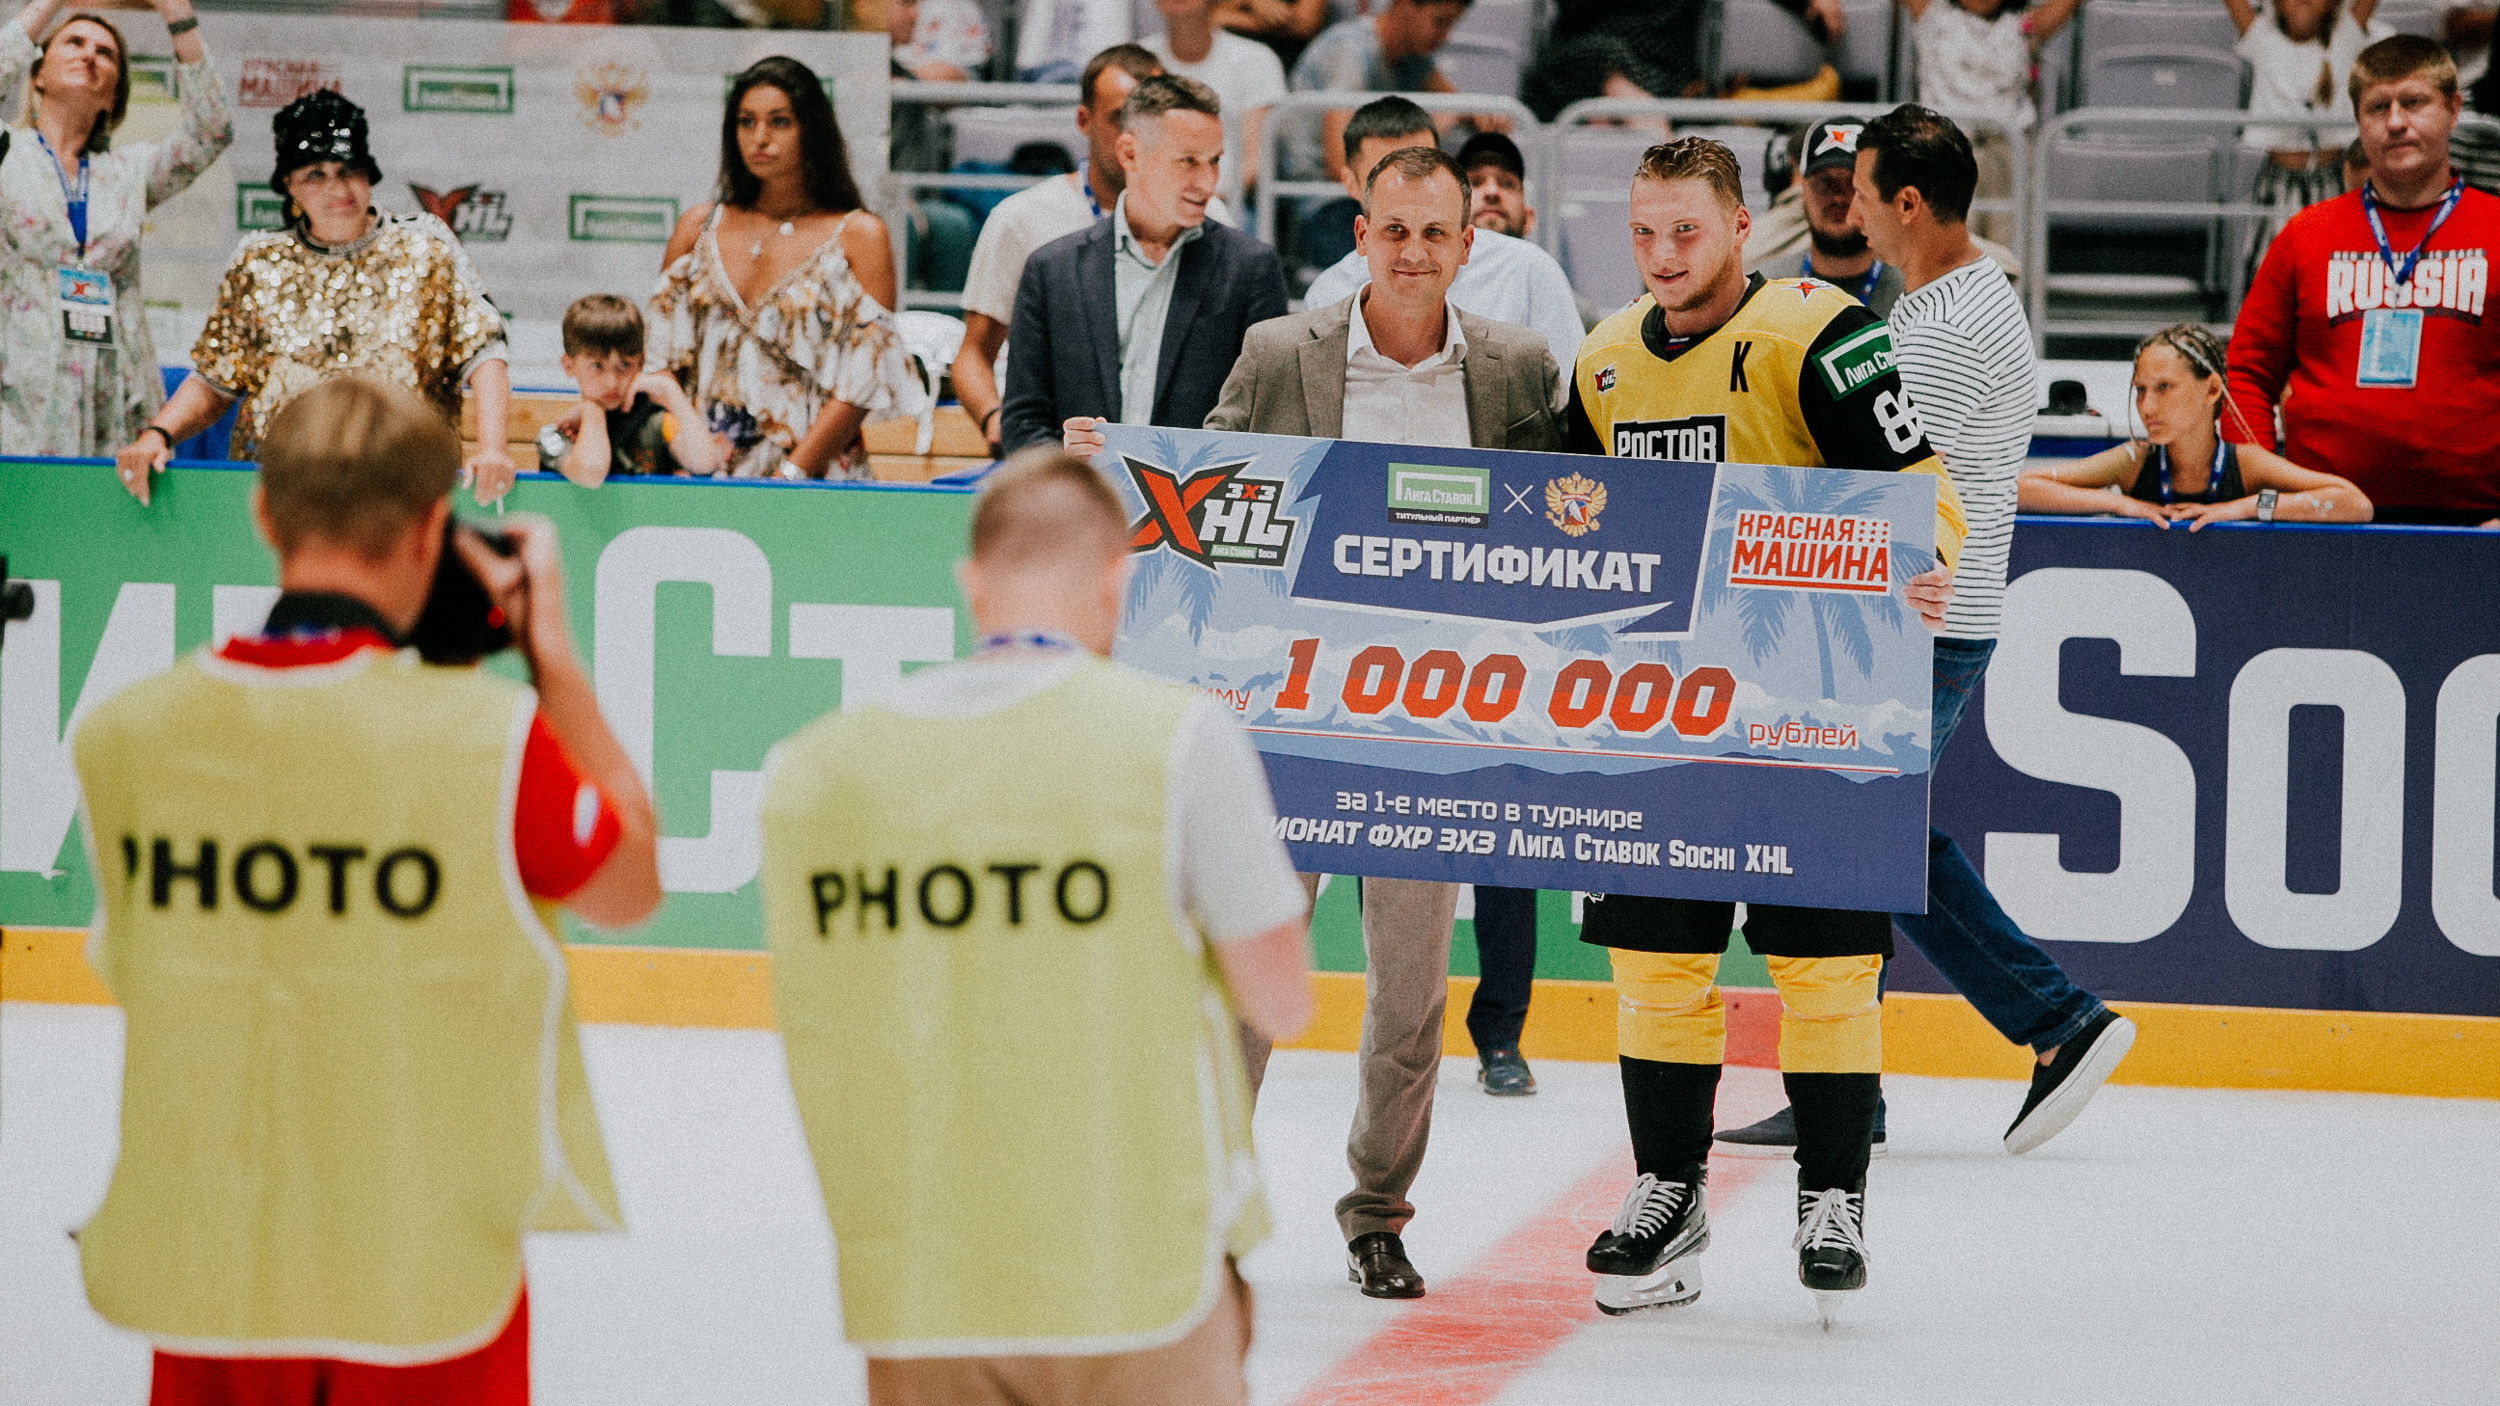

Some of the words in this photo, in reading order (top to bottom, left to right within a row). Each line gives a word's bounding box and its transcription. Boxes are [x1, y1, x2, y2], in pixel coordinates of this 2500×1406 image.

[2327, 257, 2488, 318] RUSSIA
[1617, 425, 1717, 462] РОСТОВ
[1127, 469, 1288, 555] XHL
[1395, 512, 1443, 522] ТИТУЛЬНЫЙ
[1737, 513, 1856, 542] КРАСНАЯ
[1333, 534, 1661, 593] СЕРТИФИКАТ
[1732, 539, 1888, 582] МАШИНА
[1274, 638, 1320, 711] 1
[1341, 645, 1527, 723] 000
[1548, 659, 1737, 737] 000
[1750, 722, 1857, 747] рублей
[1336, 791, 1367, 811] за
[1374, 790, 1411, 815] 1-е
[1417, 797, 1498, 820] место
[1504, 803, 1521, 822] в
[1528, 804, 1643, 832] турнире
[1271, 816, 1364, 845] ИОНАТ
[1368, 823, 1433, 850] ФХР
[1745, 844, 1794, 875] XHL
[811, 861, 1110, 935] PHOTO
